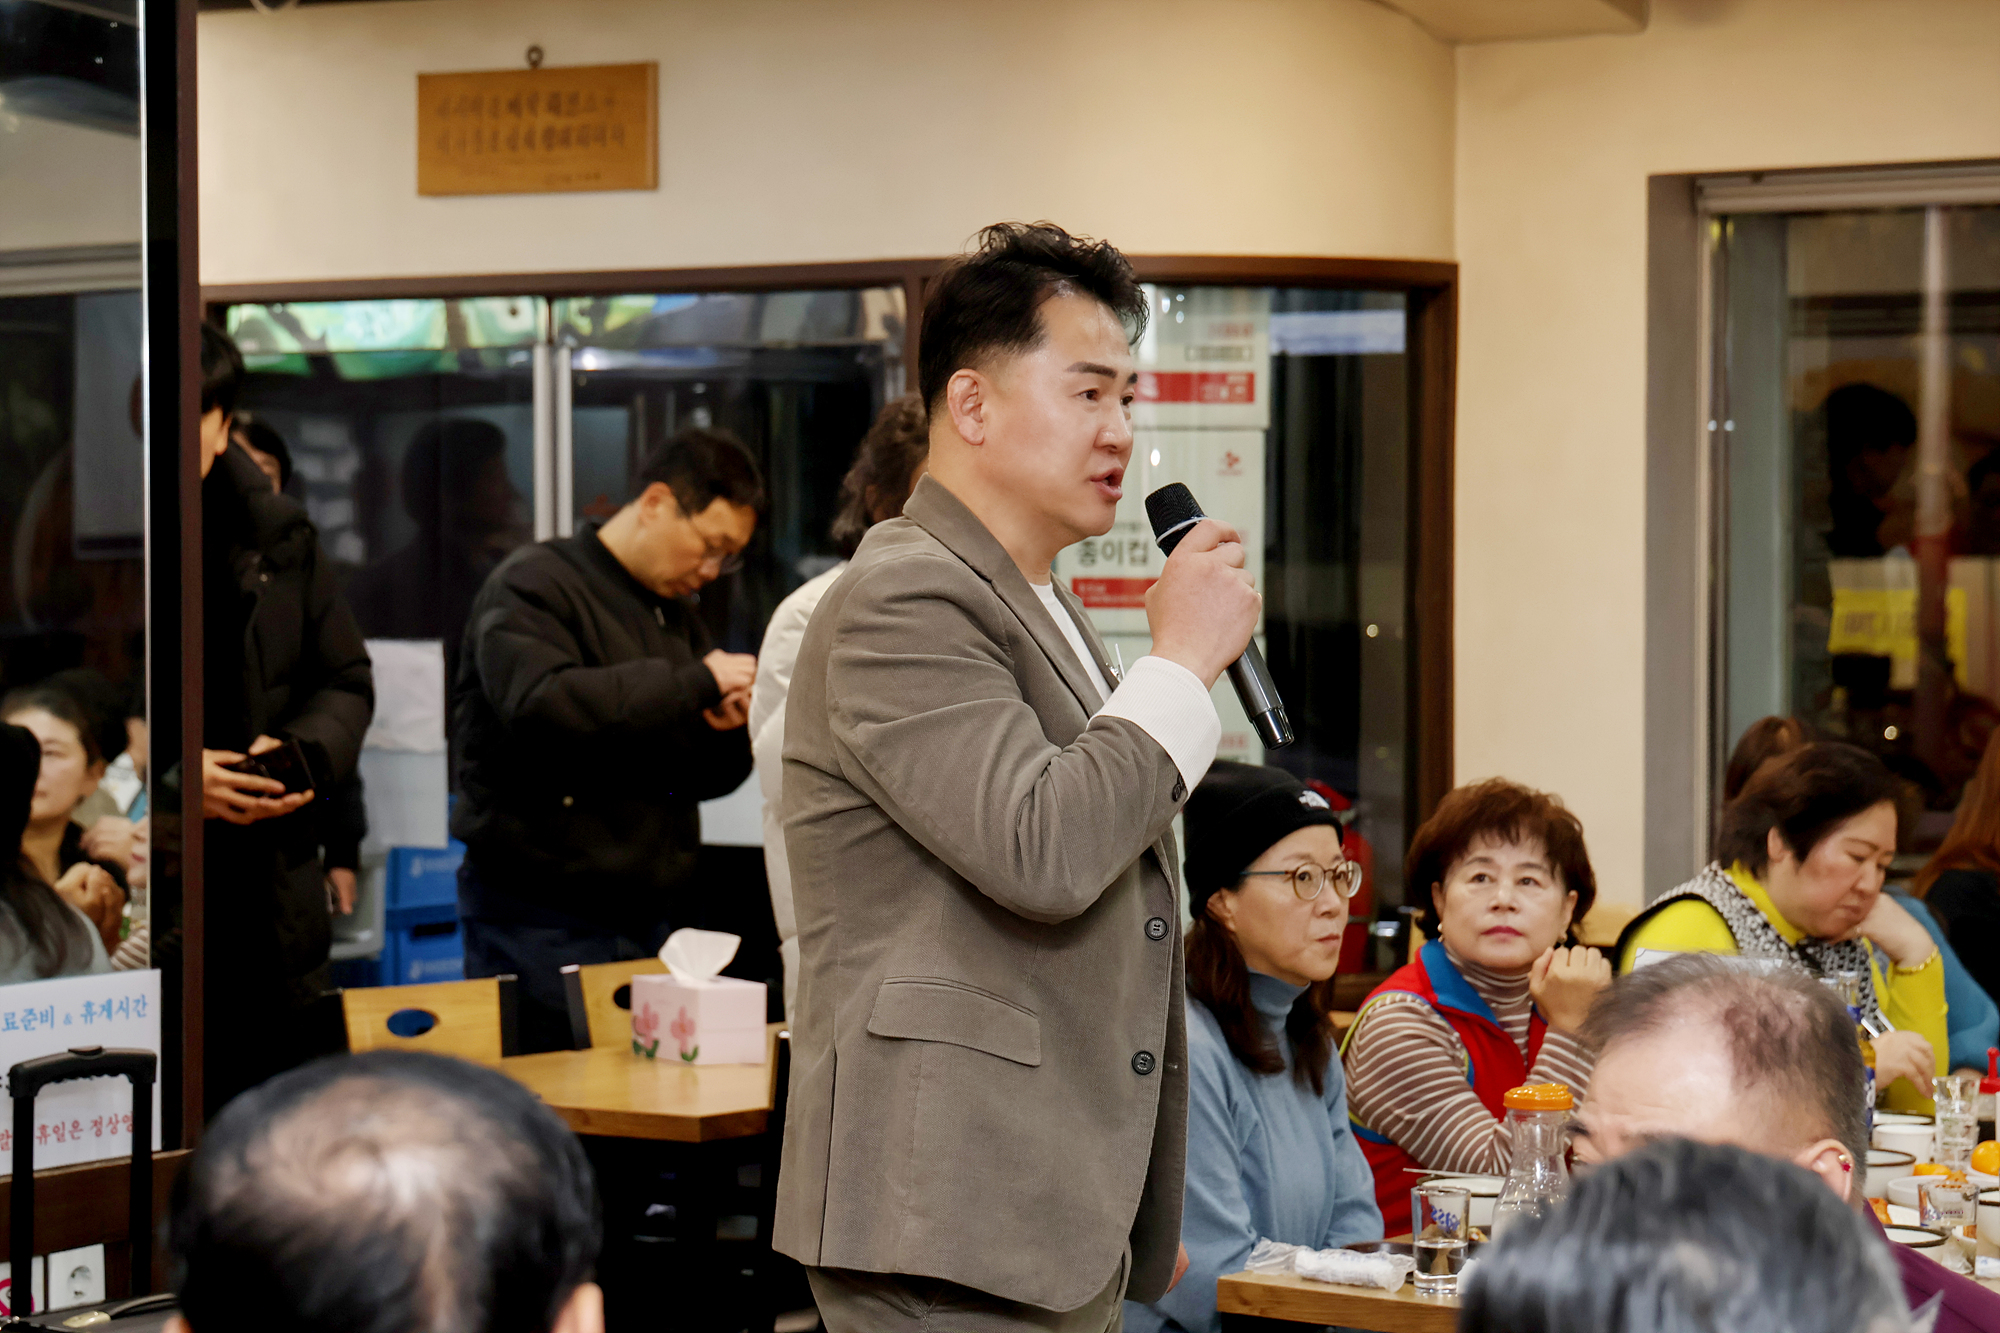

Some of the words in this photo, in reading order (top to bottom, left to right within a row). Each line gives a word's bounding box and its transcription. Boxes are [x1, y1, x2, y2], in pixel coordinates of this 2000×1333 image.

[80, 993, 148, 1025] 휴게시간
[36, 1119, 83, 1145] 휴일은
[90, 1110, 133, 1137] 정상영
